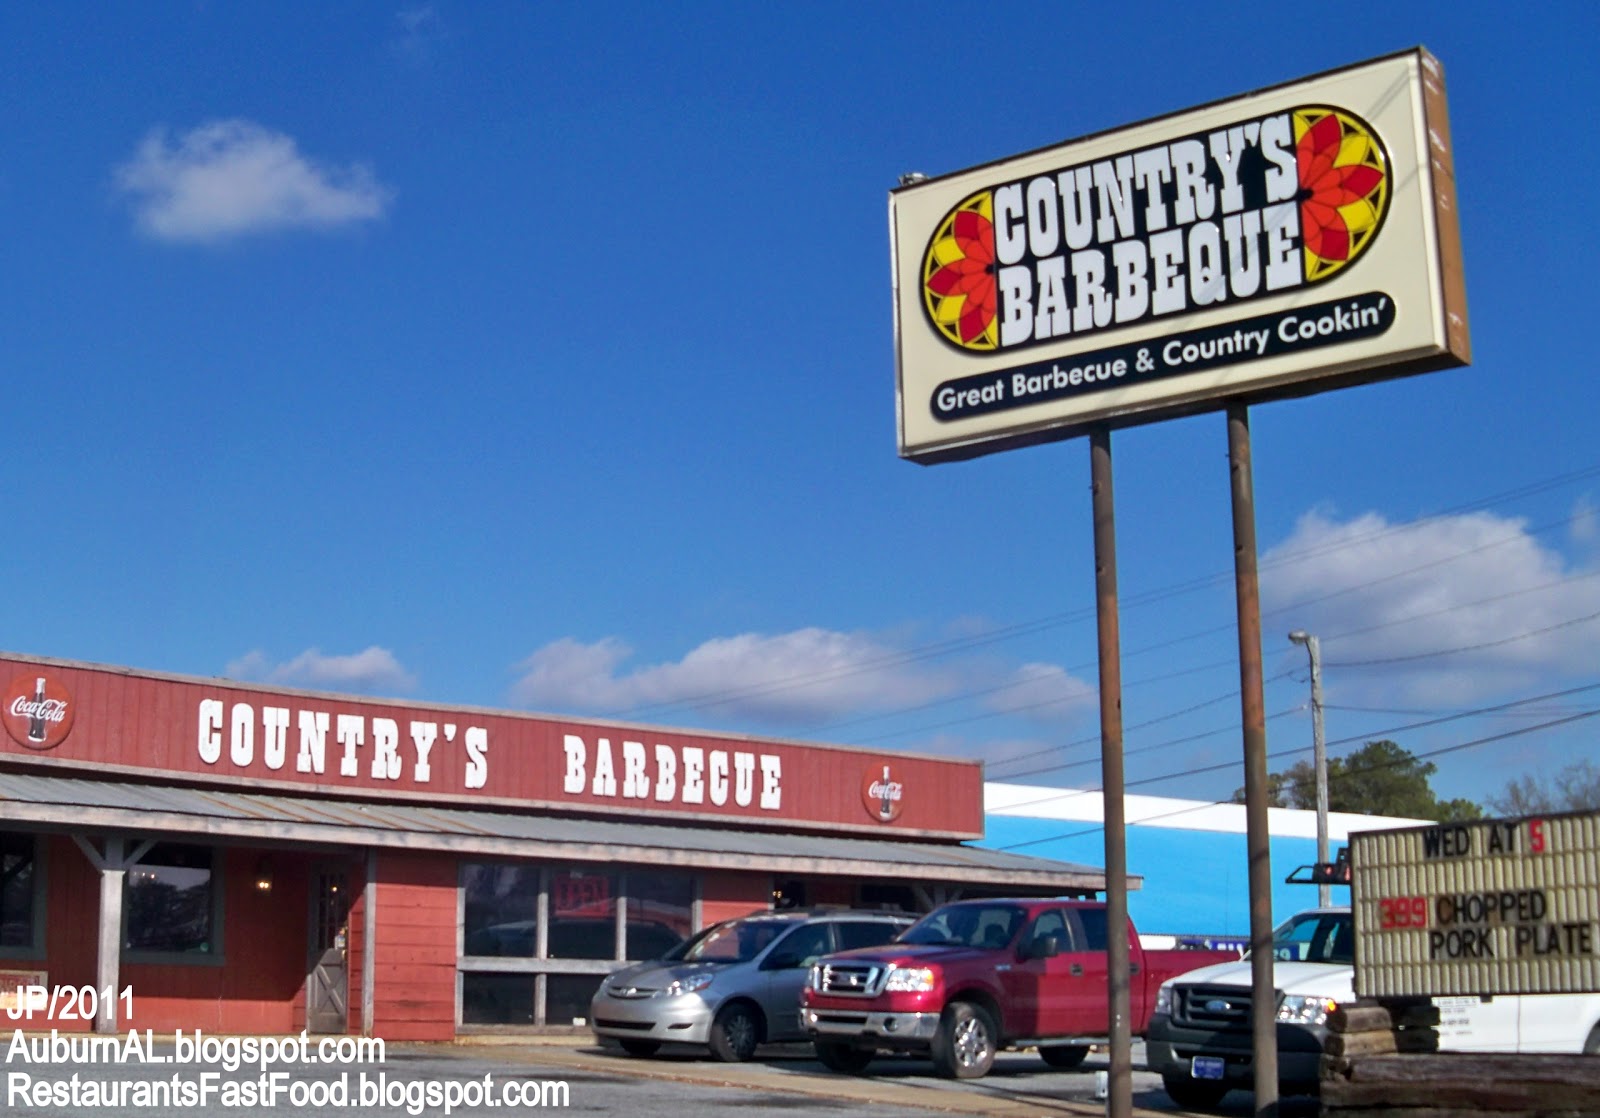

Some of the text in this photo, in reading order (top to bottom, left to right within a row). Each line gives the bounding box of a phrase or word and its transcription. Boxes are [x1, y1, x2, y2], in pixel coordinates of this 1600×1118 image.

[995, 113, 1298, 265] COUNTRY'S
[999, 201, 1302, 347] BARBEQUE
[937, 297, 1387, 412] Great Barbecue & Country Cookin'
[198, 698, 782, 810] COUNTRY'S BARBECUE
[1423, 819, 1546, 859] WED AT 5
[1430, 923, 1592, 959] PORK PLATE
[1436, 890, 1547, 925] CHOPPED
